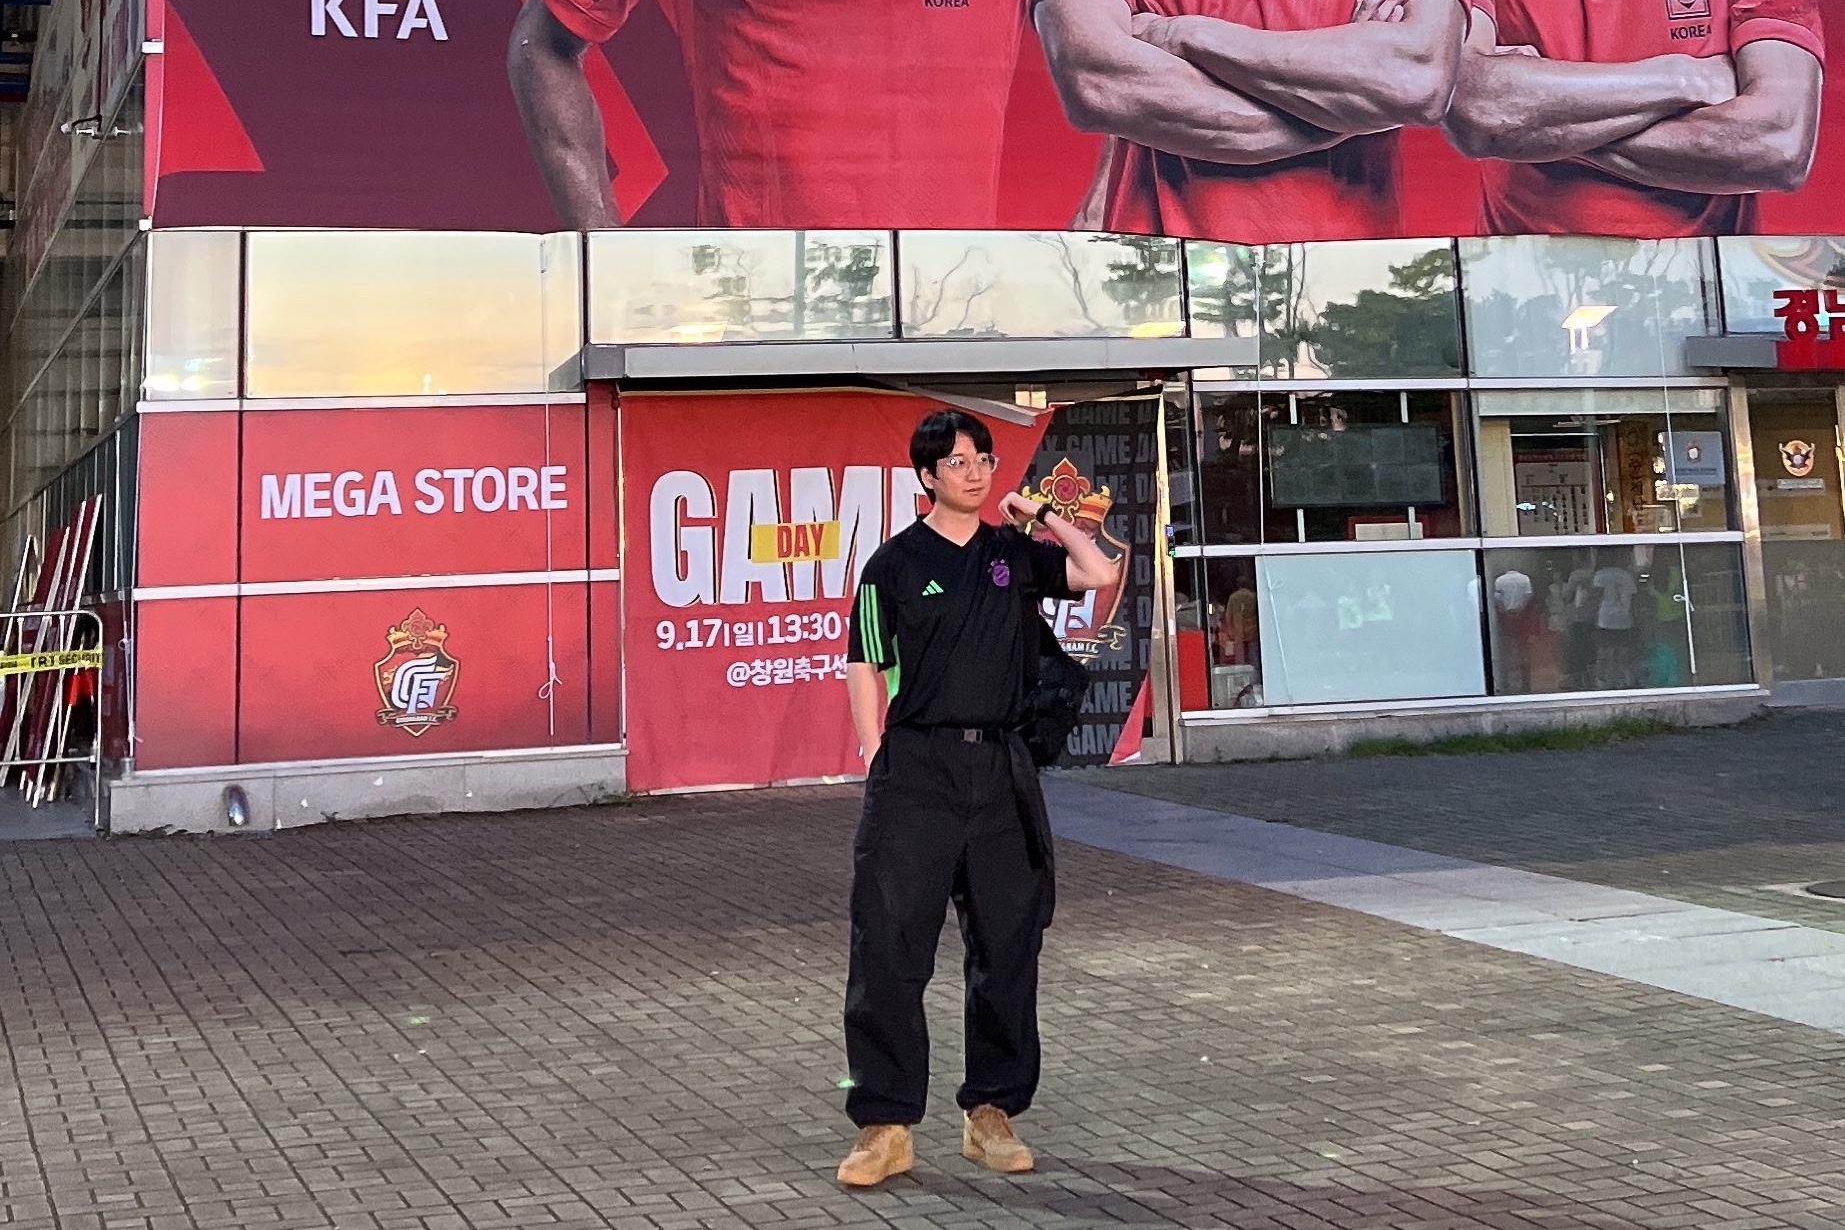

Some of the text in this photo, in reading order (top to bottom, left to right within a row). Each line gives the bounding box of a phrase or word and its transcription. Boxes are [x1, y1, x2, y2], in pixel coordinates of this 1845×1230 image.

[1670, 24, 1712, 40] KOREA
[260, 466, 568, 519] MEGA STORE
[777, 523, 825, 559] DAY
